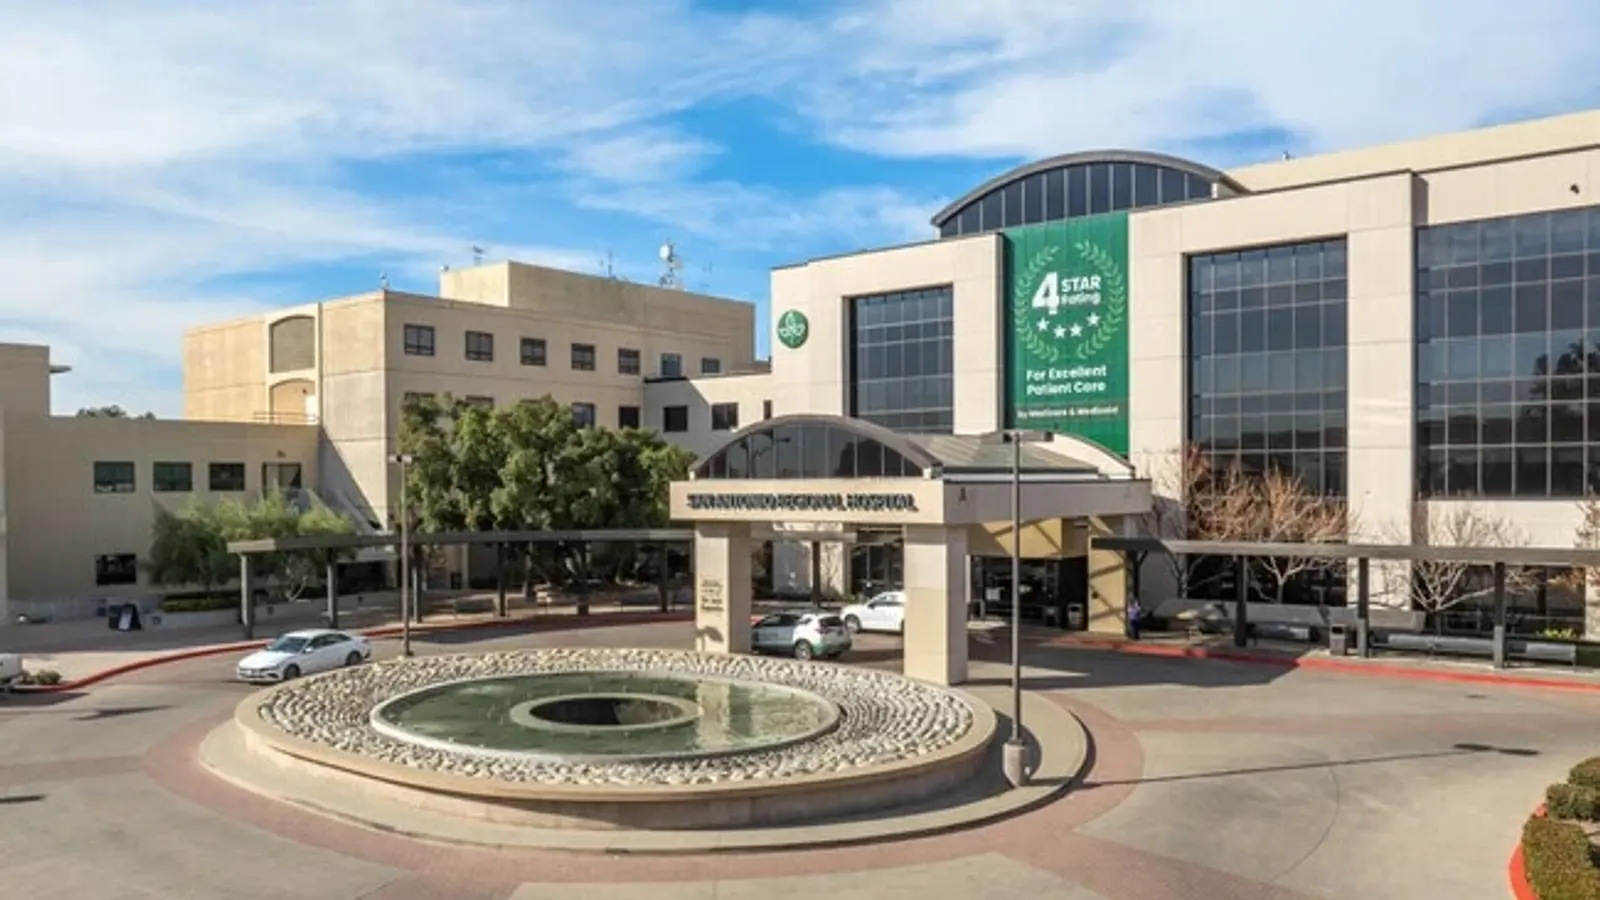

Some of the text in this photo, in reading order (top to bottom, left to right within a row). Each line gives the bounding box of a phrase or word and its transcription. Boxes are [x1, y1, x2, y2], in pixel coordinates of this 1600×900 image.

[1032, 272, 1102, 315] 4 STAR
[1061, 293, 1102, 306] Rating
[1026, 364, 1107, 381] For Excellent
[1026, 380, 1107, 396] Patient Care
[777, 493, 846, 511] REGIONAL
[847, 493, 919, 512] HOSPITAL
